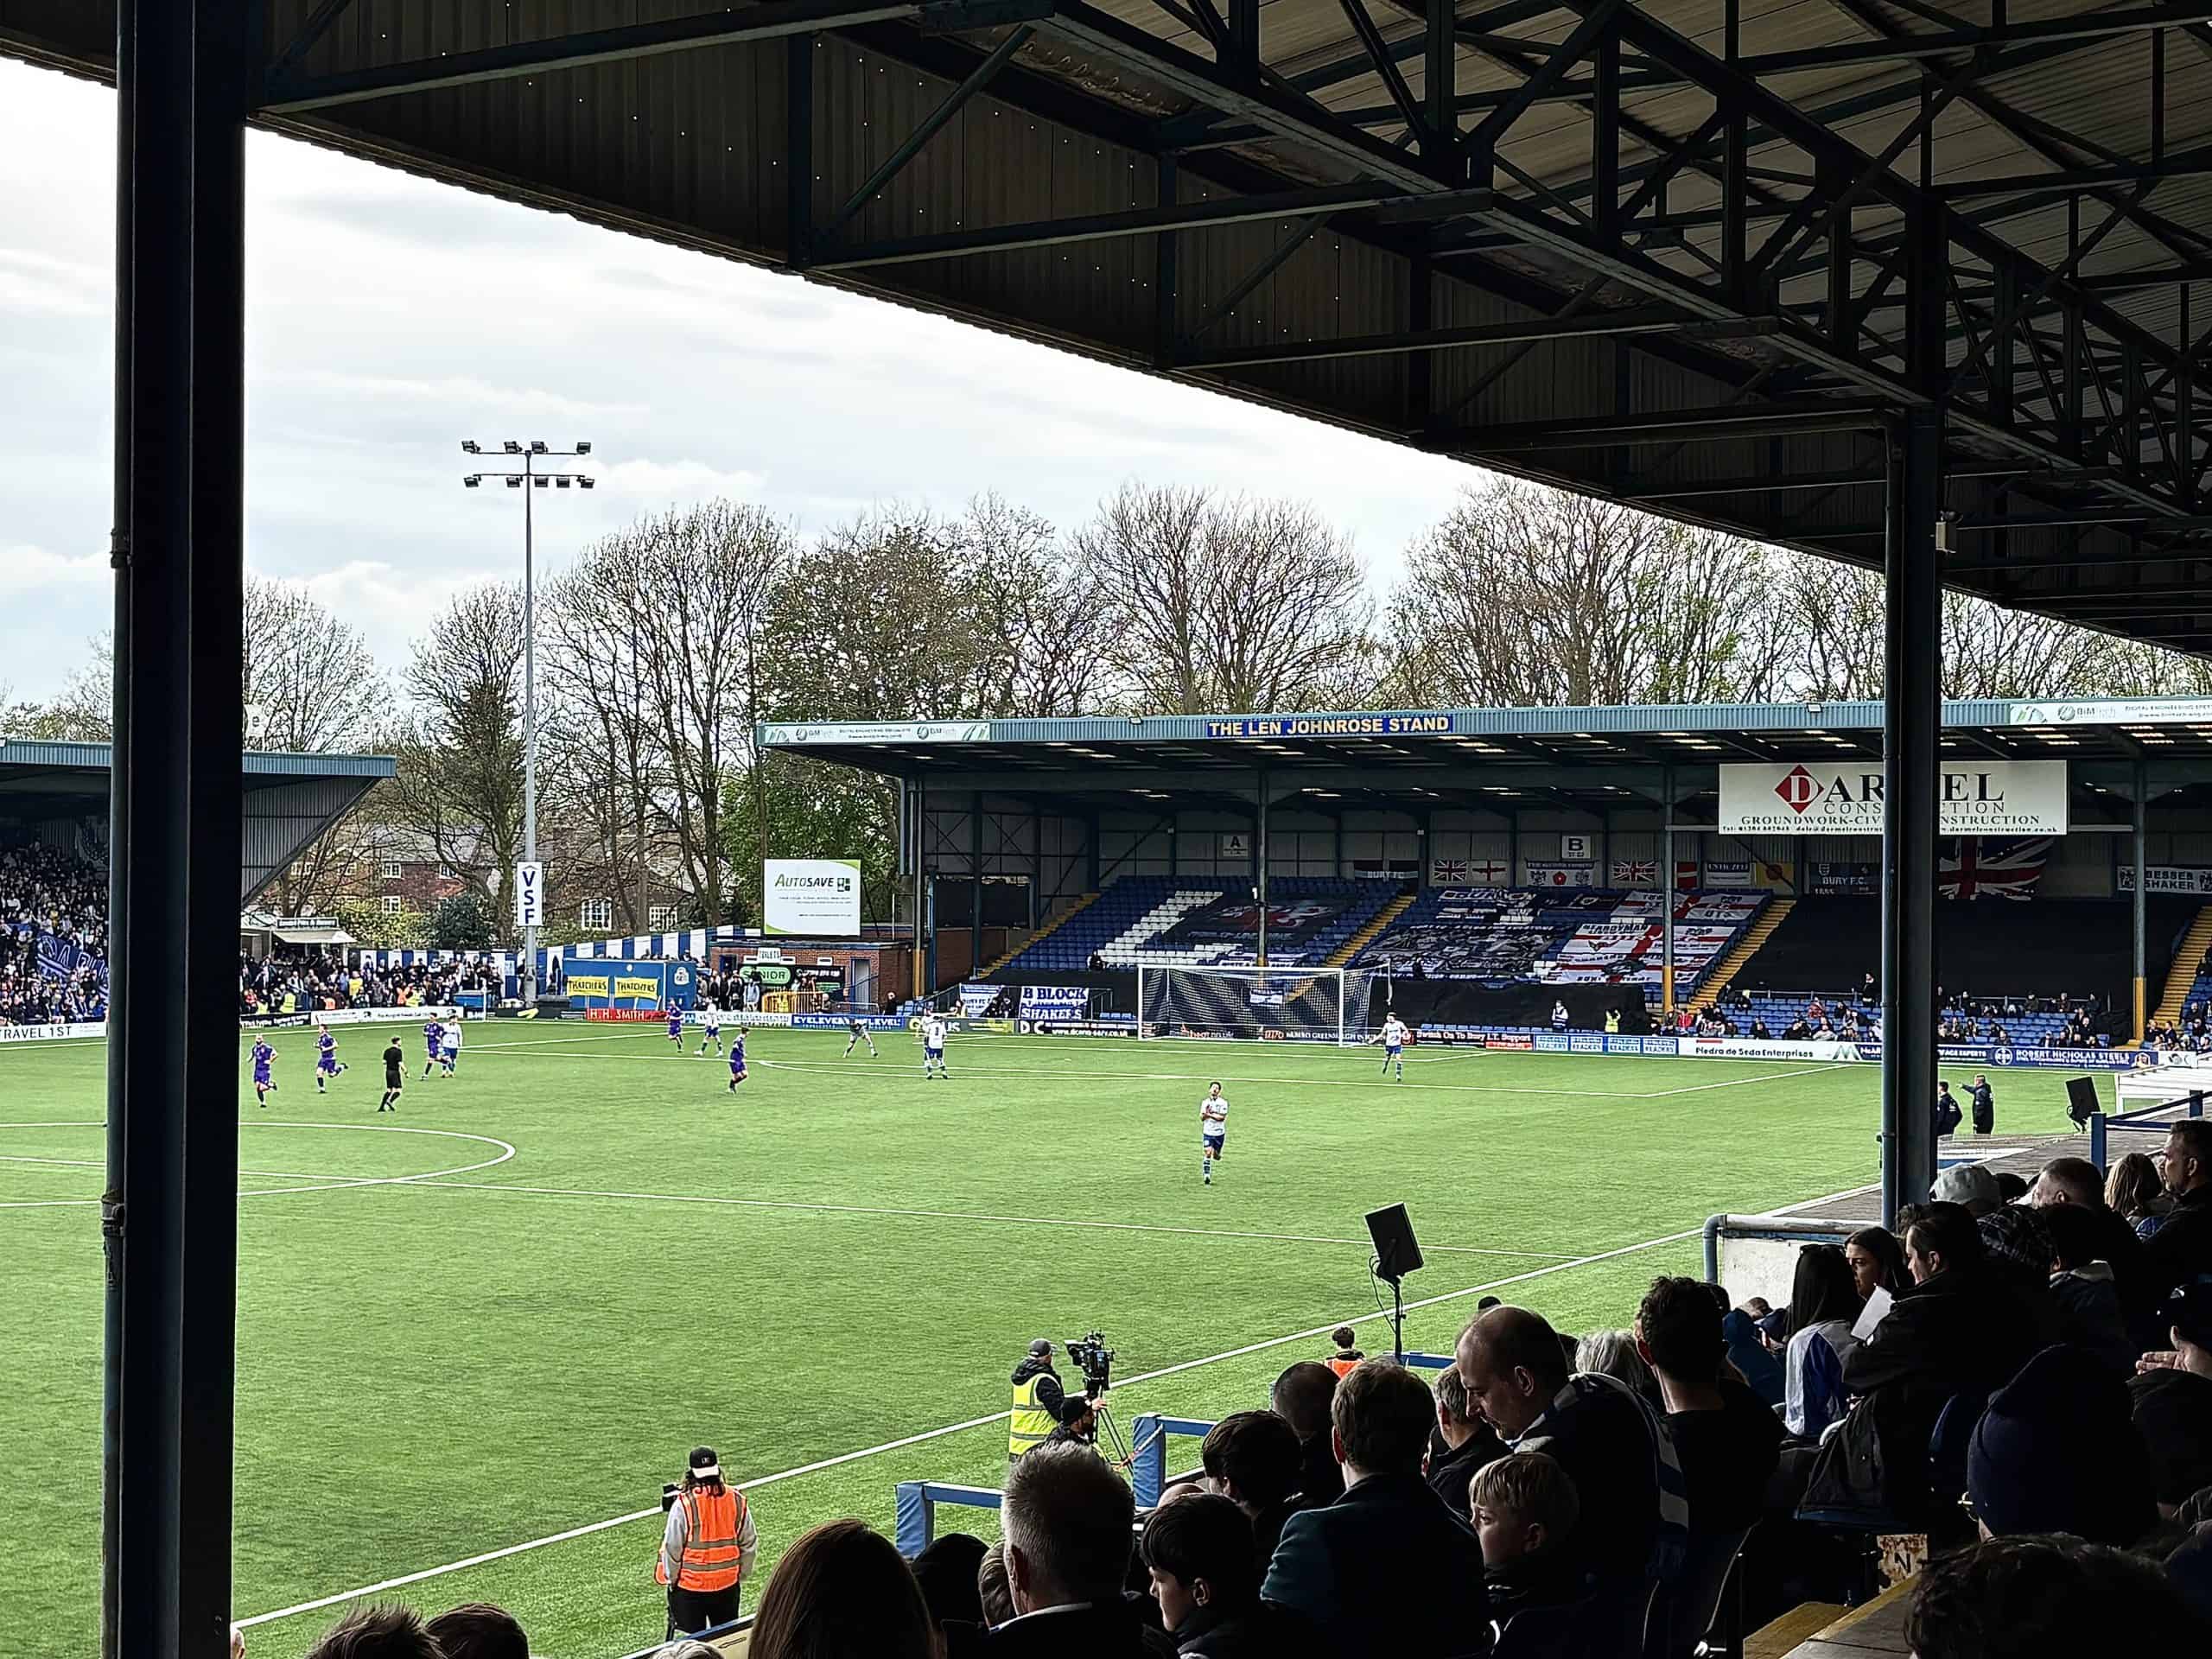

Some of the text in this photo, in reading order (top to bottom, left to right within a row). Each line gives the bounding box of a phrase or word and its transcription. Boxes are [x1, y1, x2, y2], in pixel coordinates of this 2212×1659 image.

[1209, 716, 1449, 736] THE LEN JOHNROSE STAND
[1789, 773, 2005, 803] DAREL
[1824, 802, 2005, 814] CONSTION
[1741, 815, 2040, 825] GROUNDWORK-CIV NSTRUCTION
[1230, 836, 1241, 848] A
[1568, 838, 1584, 851] B
[522, 871, 536, 925] VSF
[741, 969, 785, 982] SNIOR
[1023, 987, 1087, 1000] B BLOCK
[616, 1009, 645, 1020] SMITH
[49, 1027, 72, 1037] 1ST
[1695, 1046, 1814, 1059] Piedra de Seda Enterprises
[2016, 1049, 2050, 1058] ROBERT
[2053, 1050, 2096, 1059] NICHOLAS
